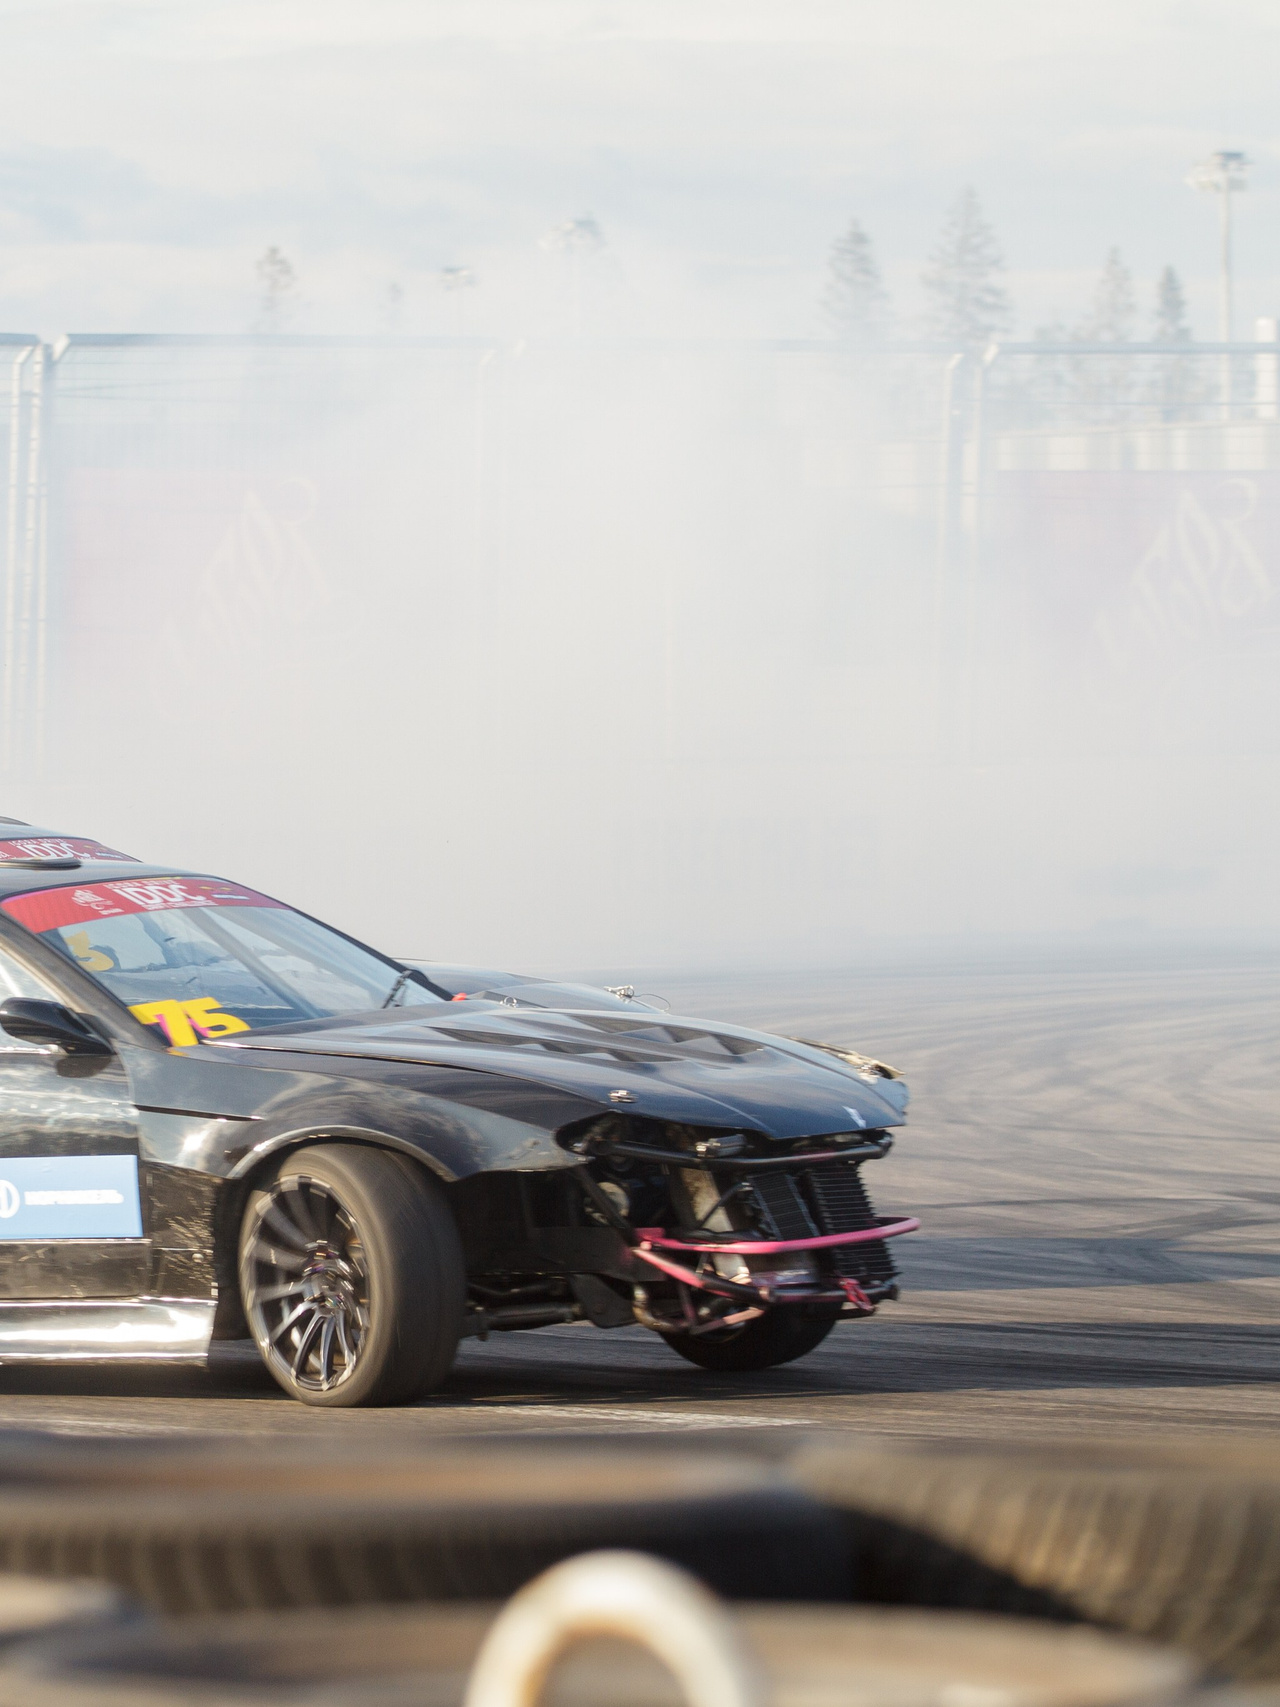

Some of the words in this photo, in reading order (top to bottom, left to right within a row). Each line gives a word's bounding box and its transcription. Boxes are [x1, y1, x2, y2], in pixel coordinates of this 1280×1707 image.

[16, 842, 91, 860] IDDC
[111, 884, 208, 906] IDDC
[126, 996, 252, 1048] 75
